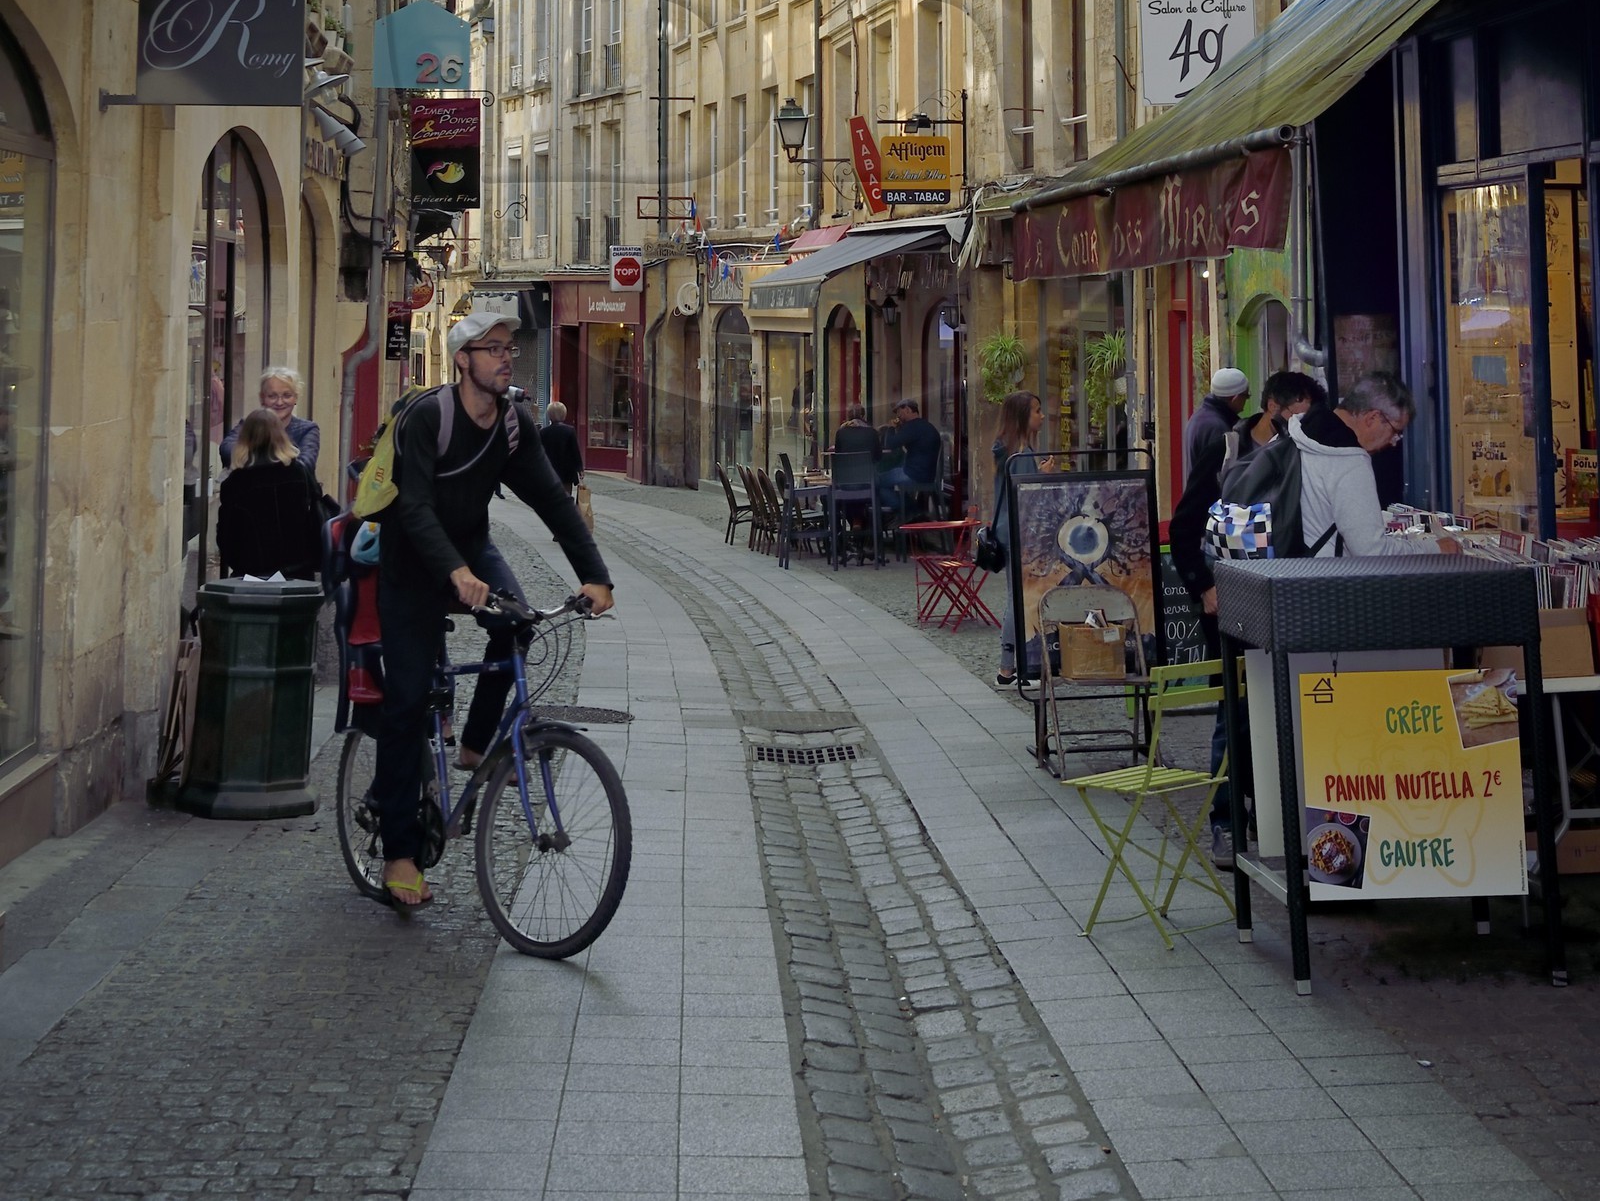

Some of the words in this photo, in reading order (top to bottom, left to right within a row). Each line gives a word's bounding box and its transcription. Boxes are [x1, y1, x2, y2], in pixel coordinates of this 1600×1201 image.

[1148, 0, 1182, 15] Salon
[1186, 0, 1198, 13] de
[416, 53, 463, 84] 26
[412, 125, 477, 140] Compagnie
[886, 142, 945, 162] Affligem
[856, 129, 881, 200] TABAC
[887, 192, 906, 202] BAR
[914, 192, 945, 202] TABAC
[616, 268, 639, 276] TOPY
[588, 296, 595, 314] Le
[1385, 700, 1444, 735] CRÊPE
[1324, 774, 1386, 802] PANINI
[1395, 771, 1474, 801] NUTELLA
[1482, 770, 1502, 798] 2€
[1379, 837, 1455, 868] GAUFRE
